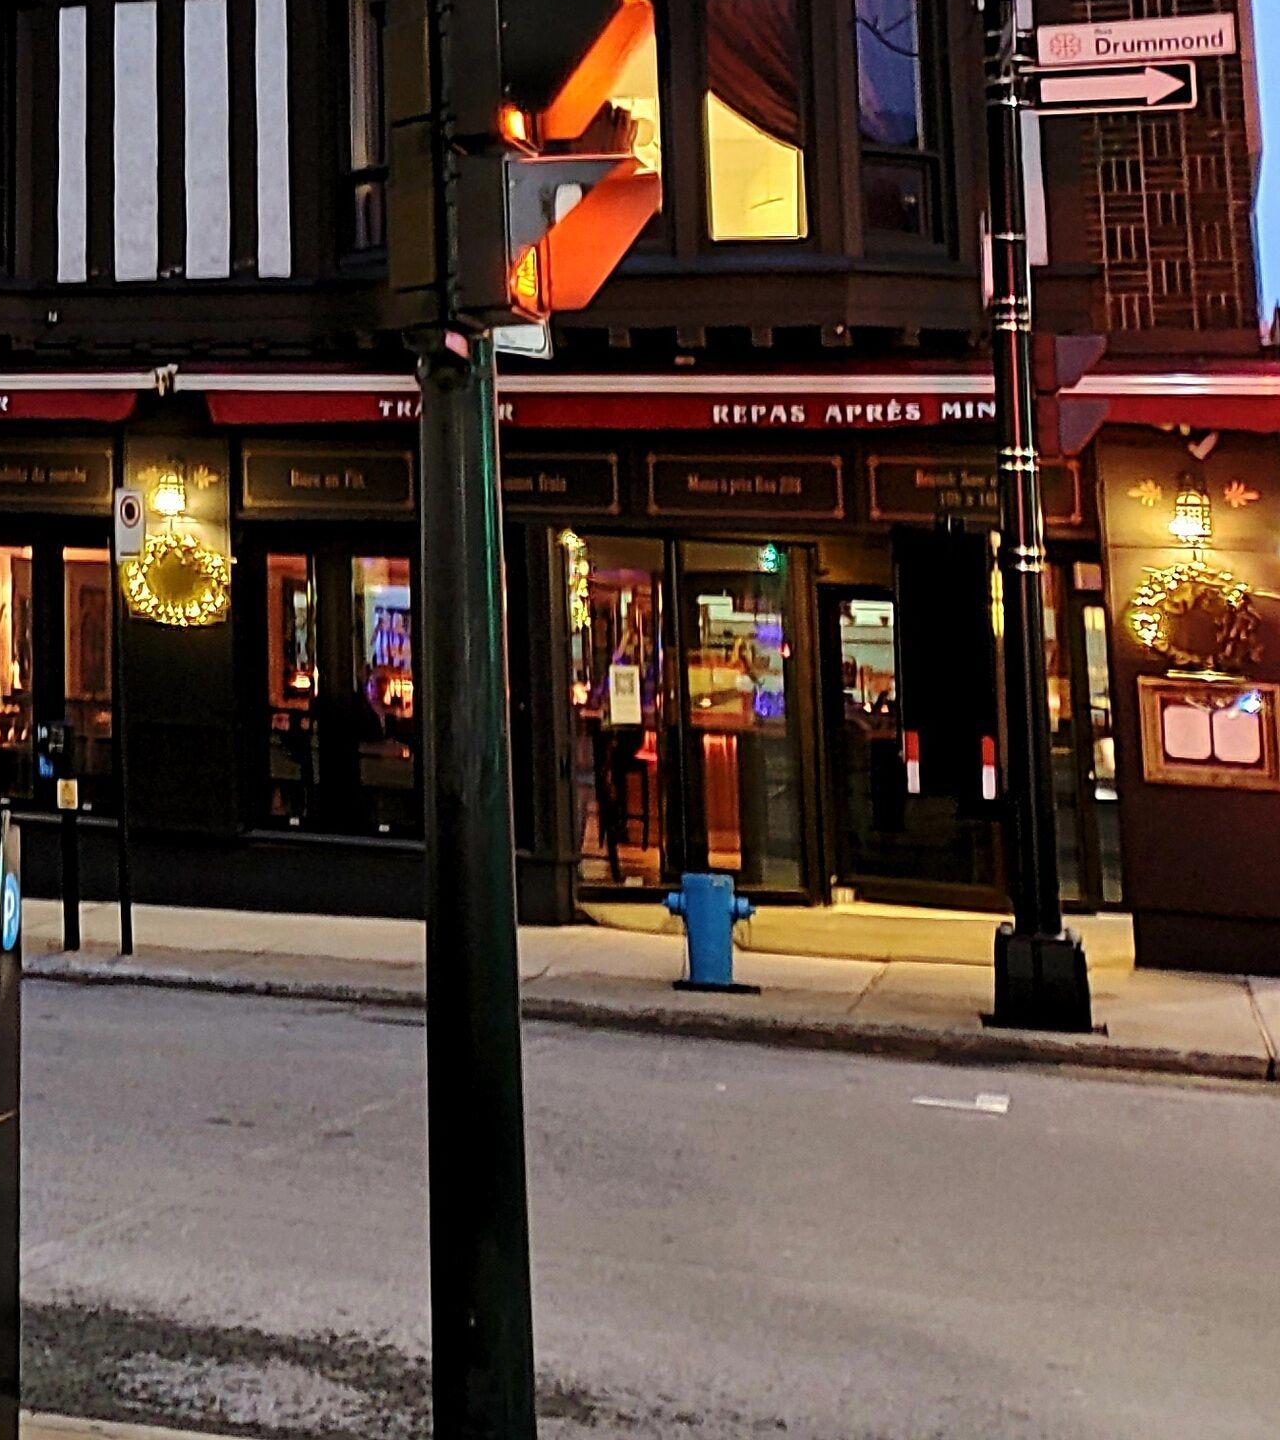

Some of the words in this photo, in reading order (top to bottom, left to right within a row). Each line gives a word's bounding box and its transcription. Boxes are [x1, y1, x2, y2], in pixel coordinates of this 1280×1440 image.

[1095, 29, 1224, 56] Drummond
[712, 404, 805, 424] REPAS
[825, 398, 921, 424] APRÈS
[941, 401, 996, 419] MIN
